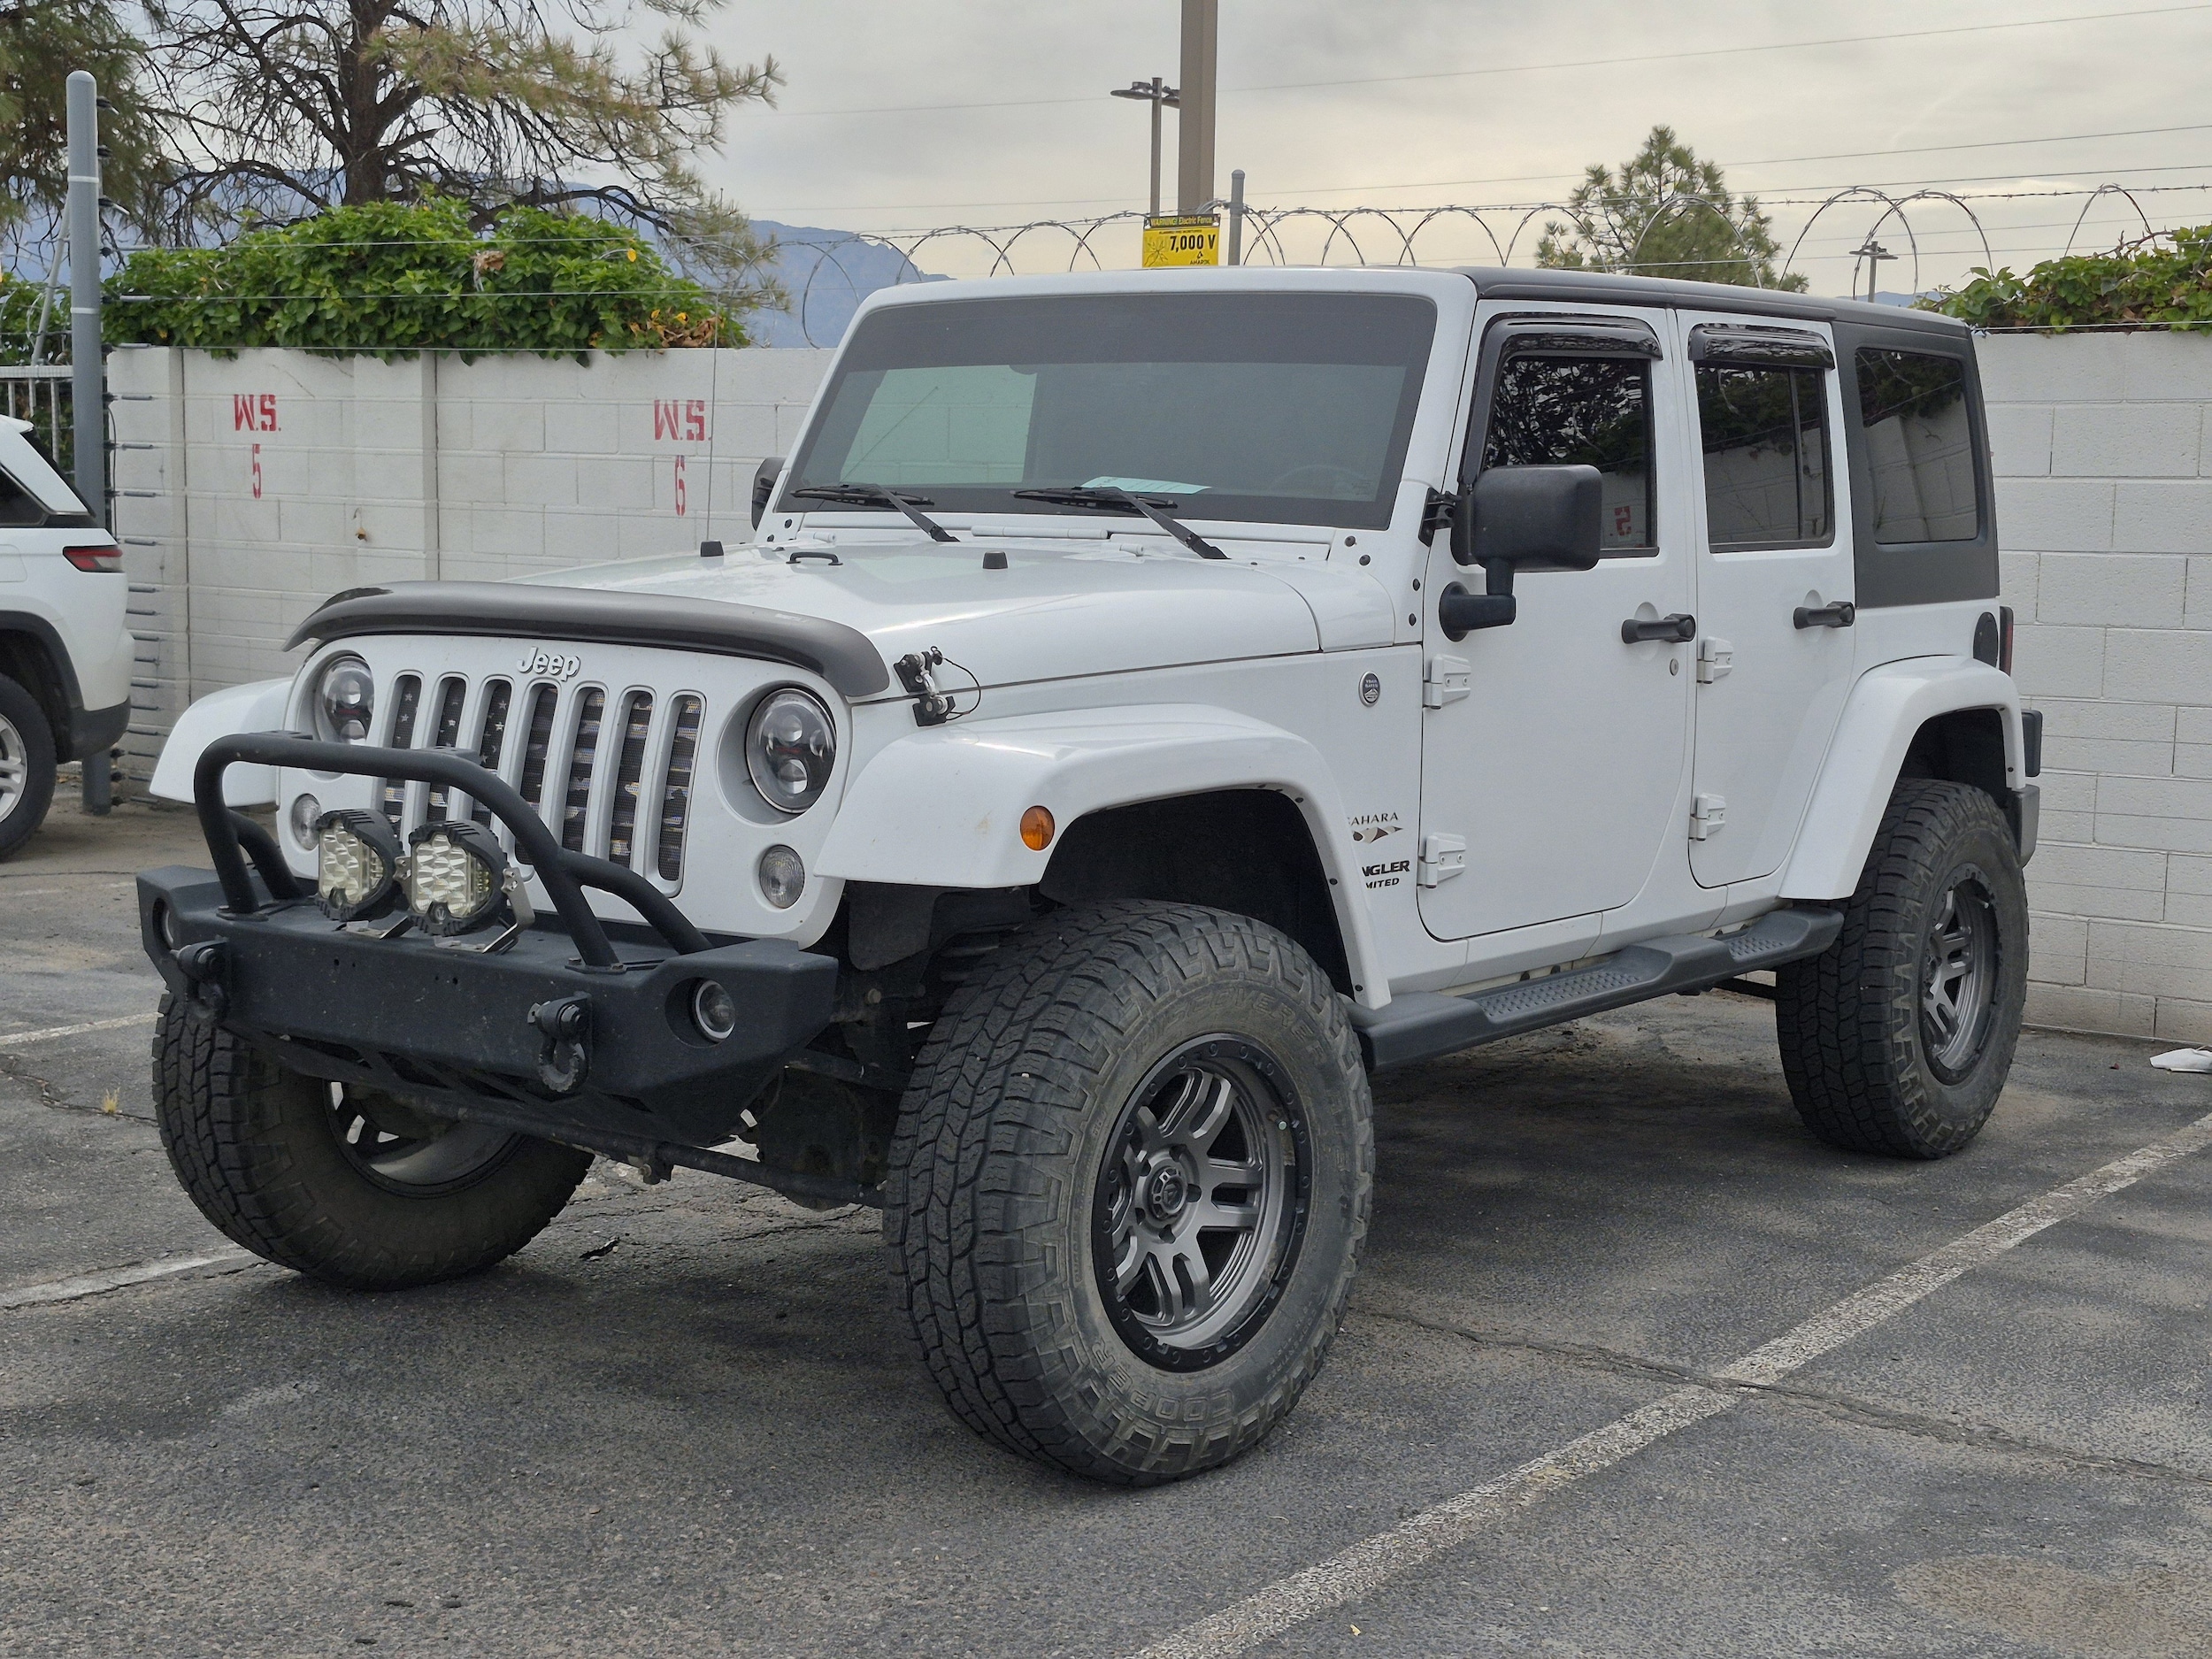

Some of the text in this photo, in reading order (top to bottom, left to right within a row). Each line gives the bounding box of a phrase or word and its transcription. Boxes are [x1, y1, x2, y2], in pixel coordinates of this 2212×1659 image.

[1170, 234, 1216, 253] 7,000 V
[234, 394, 281, 432] W.S.
[653, 399, 711, 442] W.S.
[252, 443, 262, 499] 5
[674, 454, 686, 517] 6
[516, 646, 580, 682] Jeep
[1348, 811, 1399, 826] AHARA
[1091, 1337, 1234, 1423] COOPER
